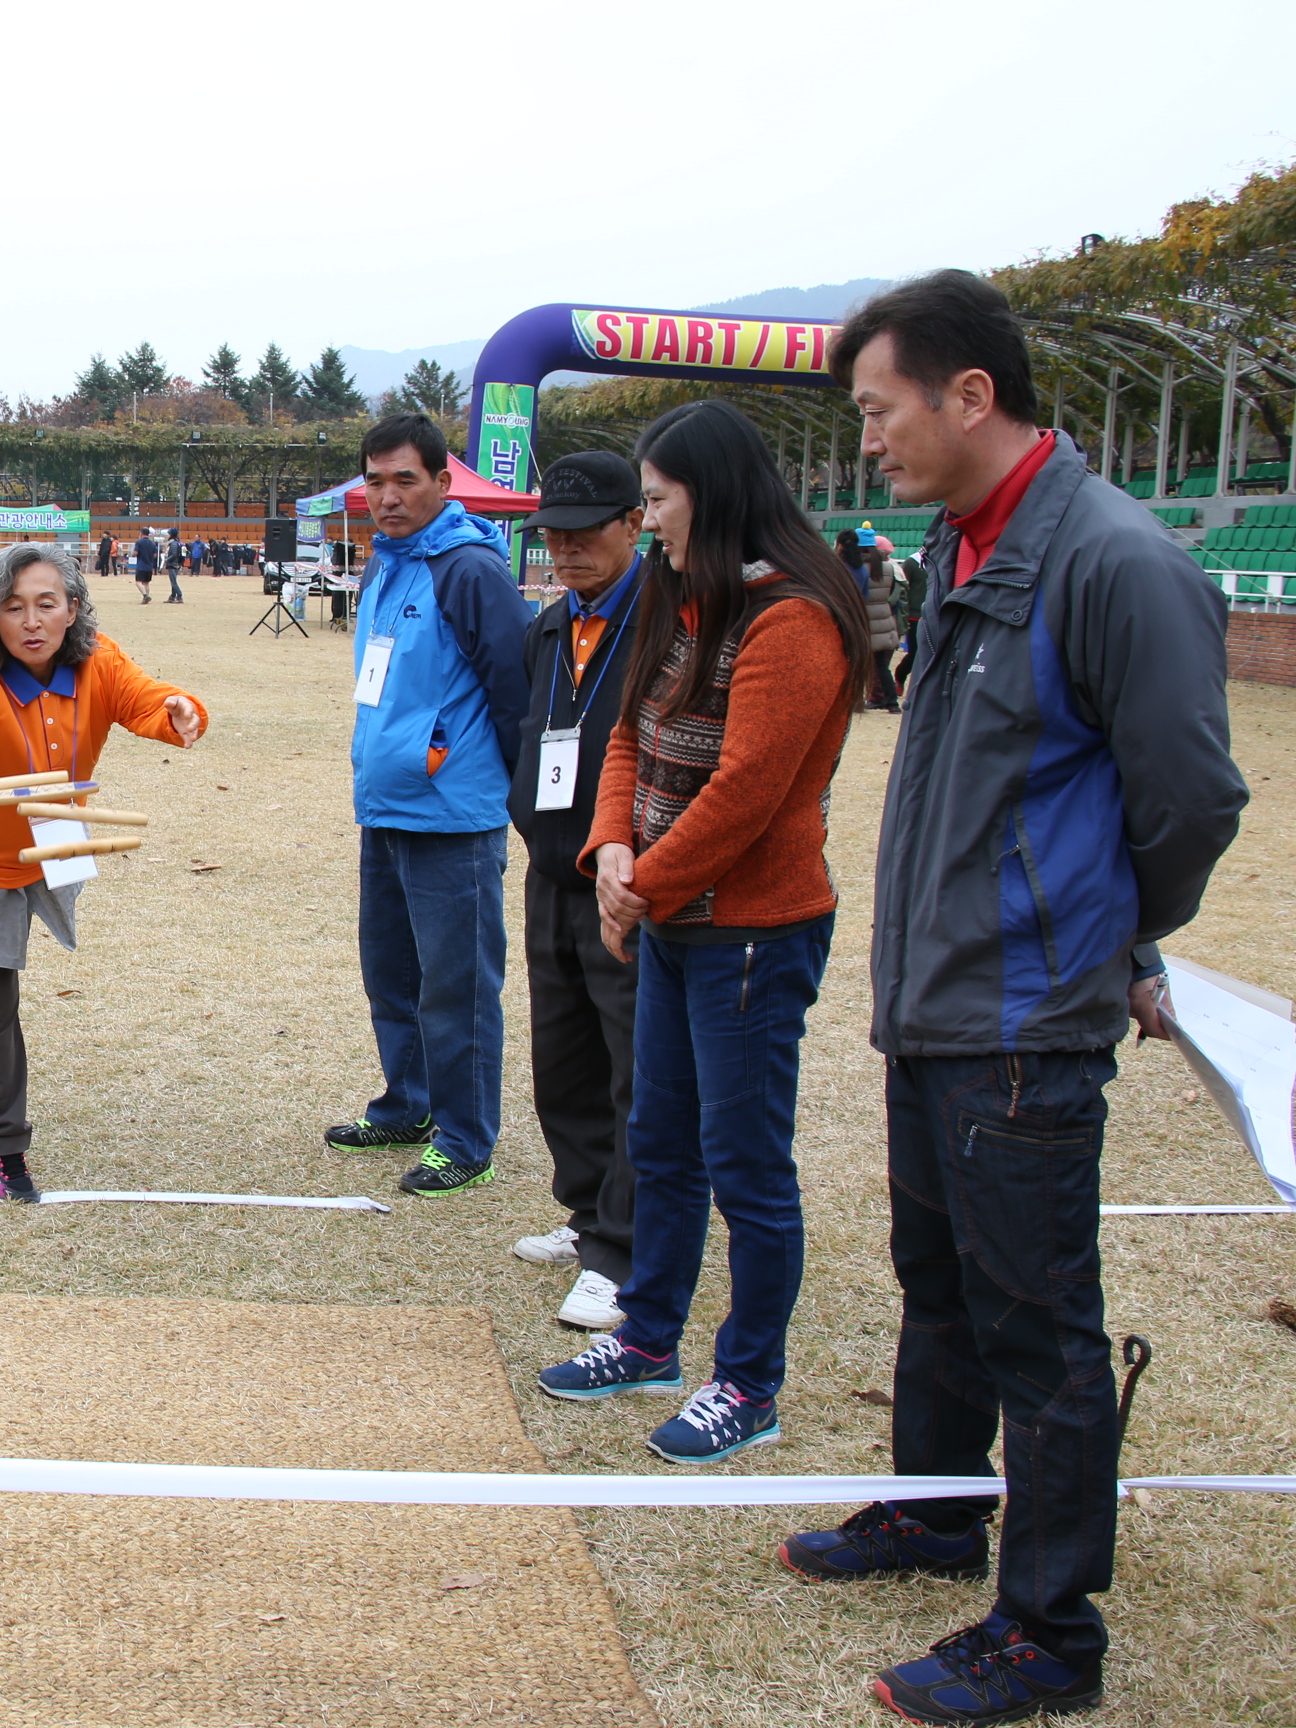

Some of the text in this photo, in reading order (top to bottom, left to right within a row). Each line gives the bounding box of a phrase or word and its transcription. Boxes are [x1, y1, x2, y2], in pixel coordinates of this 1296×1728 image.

[595, 312, 742, 367] START
[486, 413, 529, 428] NAMYOUNG
[559, 468, 598, 498] FESTIVAL
[369, 667, 375, 683] 1
[551, 766, 562, 784] 3
